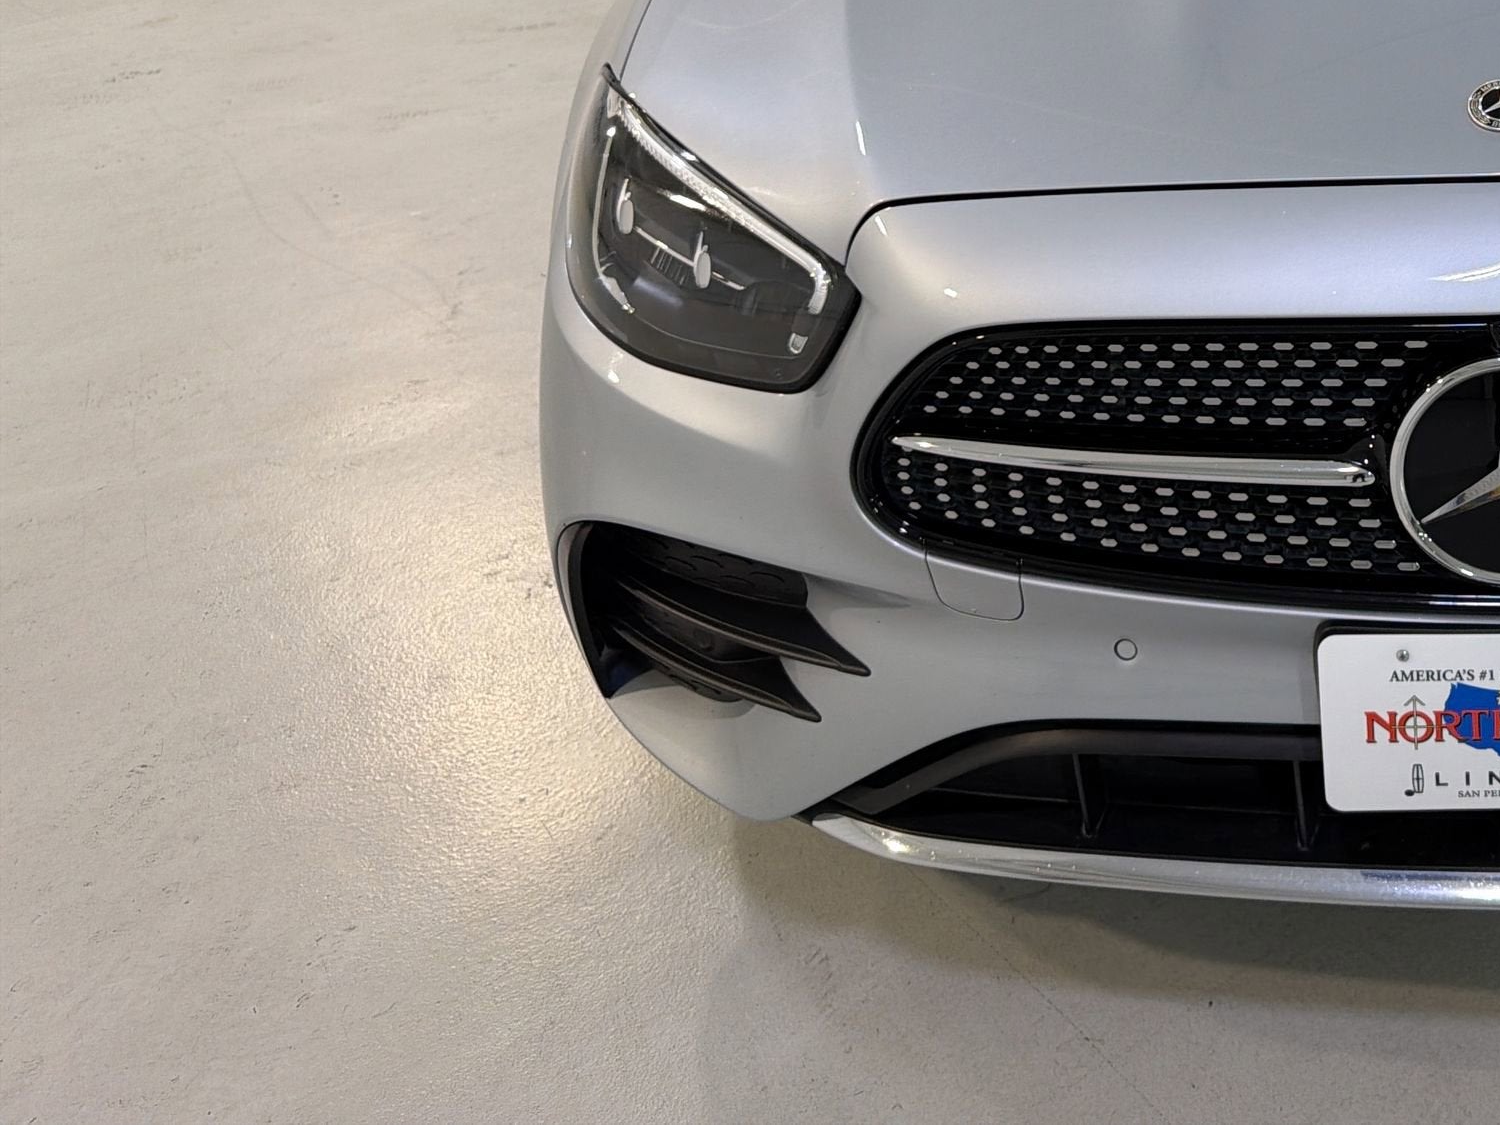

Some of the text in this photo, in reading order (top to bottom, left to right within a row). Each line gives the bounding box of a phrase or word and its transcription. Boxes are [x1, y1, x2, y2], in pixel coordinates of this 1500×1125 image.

[1389, 668, 1475, 683] AMERICA'S
[1479, 668, 1495, 681] #1
[1458, 789, 1481, 798] SAN
